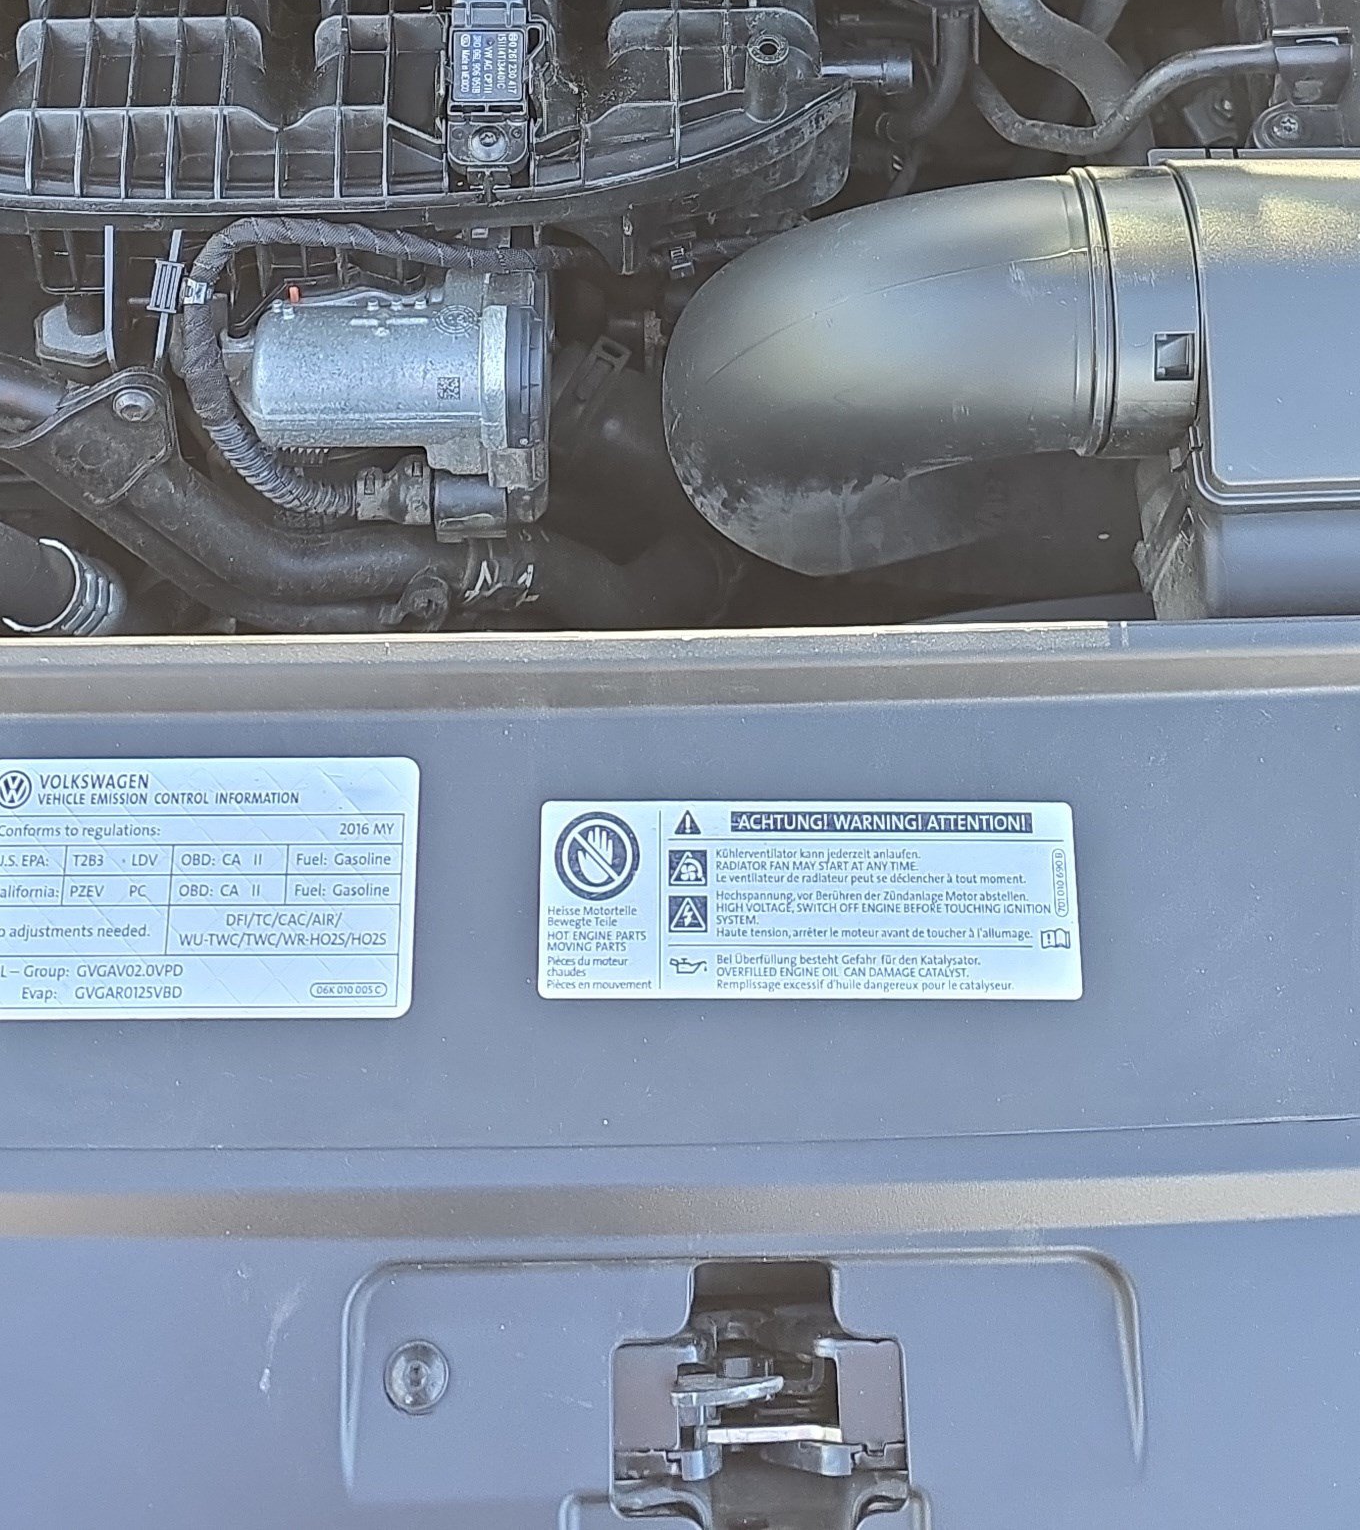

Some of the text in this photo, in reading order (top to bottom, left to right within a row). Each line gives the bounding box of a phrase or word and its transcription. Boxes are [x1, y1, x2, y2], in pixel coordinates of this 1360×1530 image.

[39, 774, 149, 789] VOLKSWAGEN
[38, 792, 300, 805] VEHICLE EMISSION CONTROL INFORMATION
[738, 814, 1026, 831] ACHTUNG! WARNING! ATTENTION!
[65, 826, 78, 836] to
[82, 824, 161, 840] regulations:
[339, 823, 394, 835] 2016 MY
[73, 854, 158, 866] T2B3 LDV
[181, 854, 216, 866] OBD:
[222, 853, 241, 866] CA
[296, 853, 391, 865] Fuel: Gasoline
[716, 849, 921, 859] Kühlerventilator kann jederzeit anlaufen.
[21, 854, 49, 867] EPA:
[716, 861, 919, 871] RADIATOR FAN MAY START AT ANY TIME.
[716, 874, 727, 883] Le
[729, 873, 784, 883] ventilateur
[787, 873, 800, 883] de
[802, 873, 848, 883] radiateur
[850, 876, 874, 886] peut
[876, 875, 888, 883] se
[890, 874, 944, 884] déclencher
[956, 874, 976, 884] tout
[980, 876, 1026, 884] moment.
[70, 885, 146, 897] PZEV PC
[179, 885, 213, 897] OBD:
[220, 884, 239, 896] CA
[294, 884, 390, 896] Fuel: Gasoline
[716, 903, 1051, 914] HIGH VOLTAGE, SWITCH OFF ENGINE BEFORE TOUCHING IGNITION
[716, 915, 760, 925] SYSTEM.
[9, 925, 93, 941] adjustments
[97, 925, 150, 937] needed.
[547, 931, 647, 941] HOT ENGINE PARTS
[716, 928, 748, 938] Haute
[750, 928, 791, 939] tension,
[792, 927, 828, 938] arrêter
[830, 927, 839, 938] le
[841, 929, 879, 939] moteur
[881, 929, 910, 939] avant
[912, 928, 924, 939] de
[927, 928, 967, 939] toucher
[977, 928, 1033, 941] l'allumage.
[547, 942, 627, 952] MOVING PARTS
[23, 965, 69, 981] Group:
[716, 967, 969, 978] OVERFILLED ENGINE OIL CAN DAMAGE CATALYST.
[22, 987, 57, 1002] Evap:
